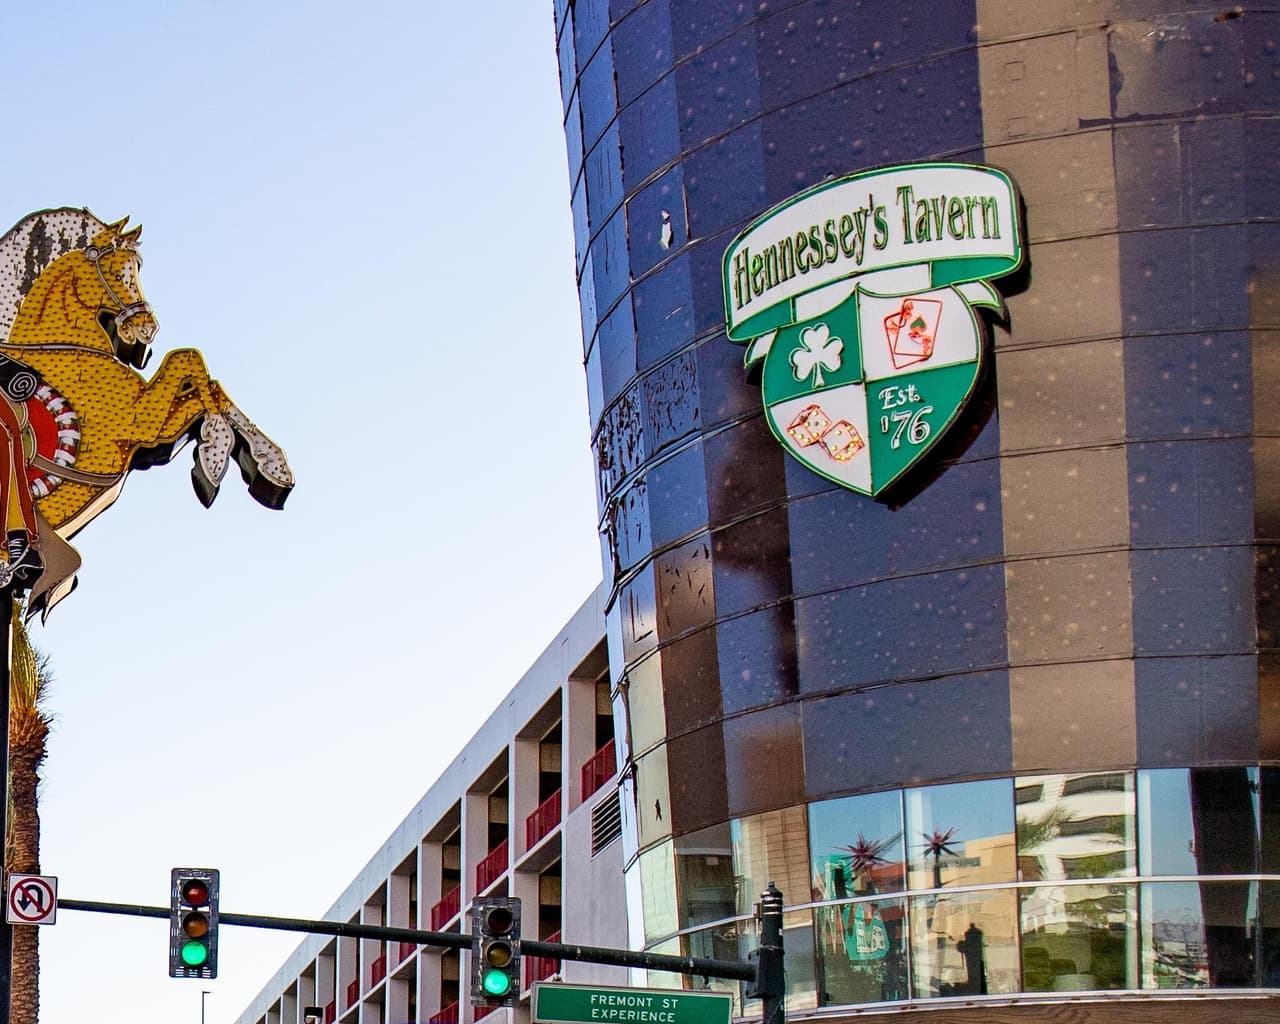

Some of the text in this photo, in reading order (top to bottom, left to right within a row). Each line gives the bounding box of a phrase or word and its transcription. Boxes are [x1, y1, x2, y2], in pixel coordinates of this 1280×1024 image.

[733, 184, 1001, 311] Hennessey's Tavern
[878, 384, 921, 410] Est.
[880, 406, 933, 450] '76
[590, 994, 678, 1009] FREMONT ST
[591, 1009, 676, 1023] EXPERIENCE
